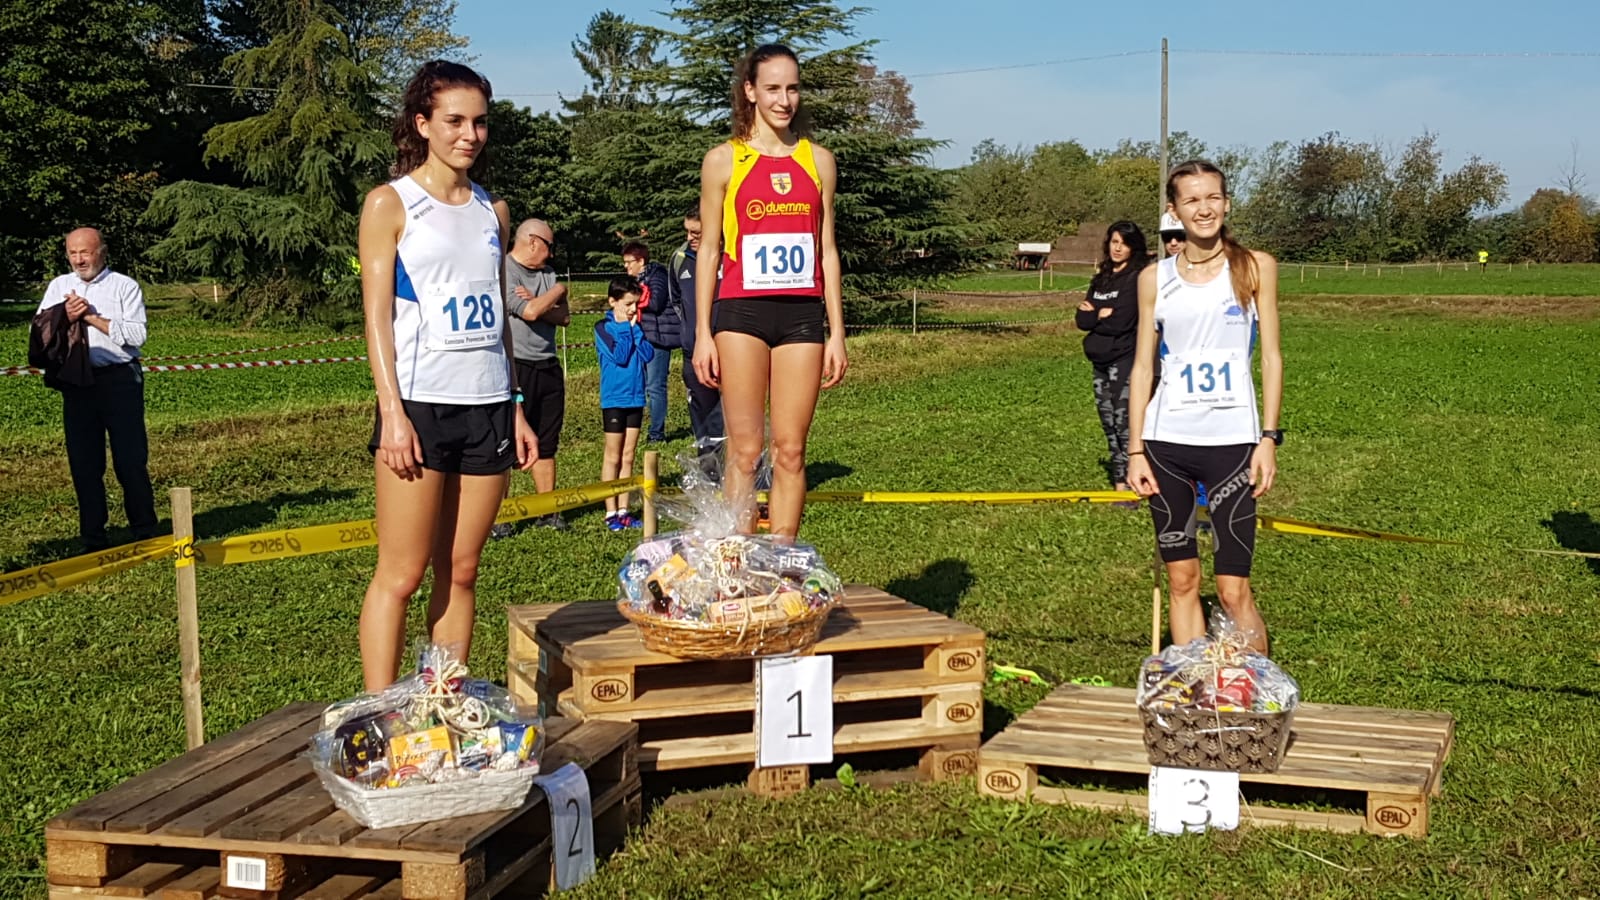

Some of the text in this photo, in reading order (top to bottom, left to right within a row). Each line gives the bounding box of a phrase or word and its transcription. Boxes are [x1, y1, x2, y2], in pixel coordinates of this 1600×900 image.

[766, 201, 811, 213] duemme
[755, 245, 805, 274] 130
[443, 294, 496, 331] 128
[1180, 362, 1231, 394] 131
[952, 656, 974, 668] EPAL
[597, 682, 624, 698] EPAL
[786, 689, 812, 739] 1
[951, 707, 973, 719] EPAL
[991, 774, 1016, 789] EPAL
[1180, 778, 1212, 826] 3
[566, 798, 583, 858] 2
[1380, 810, 1405, 825] EPAL
